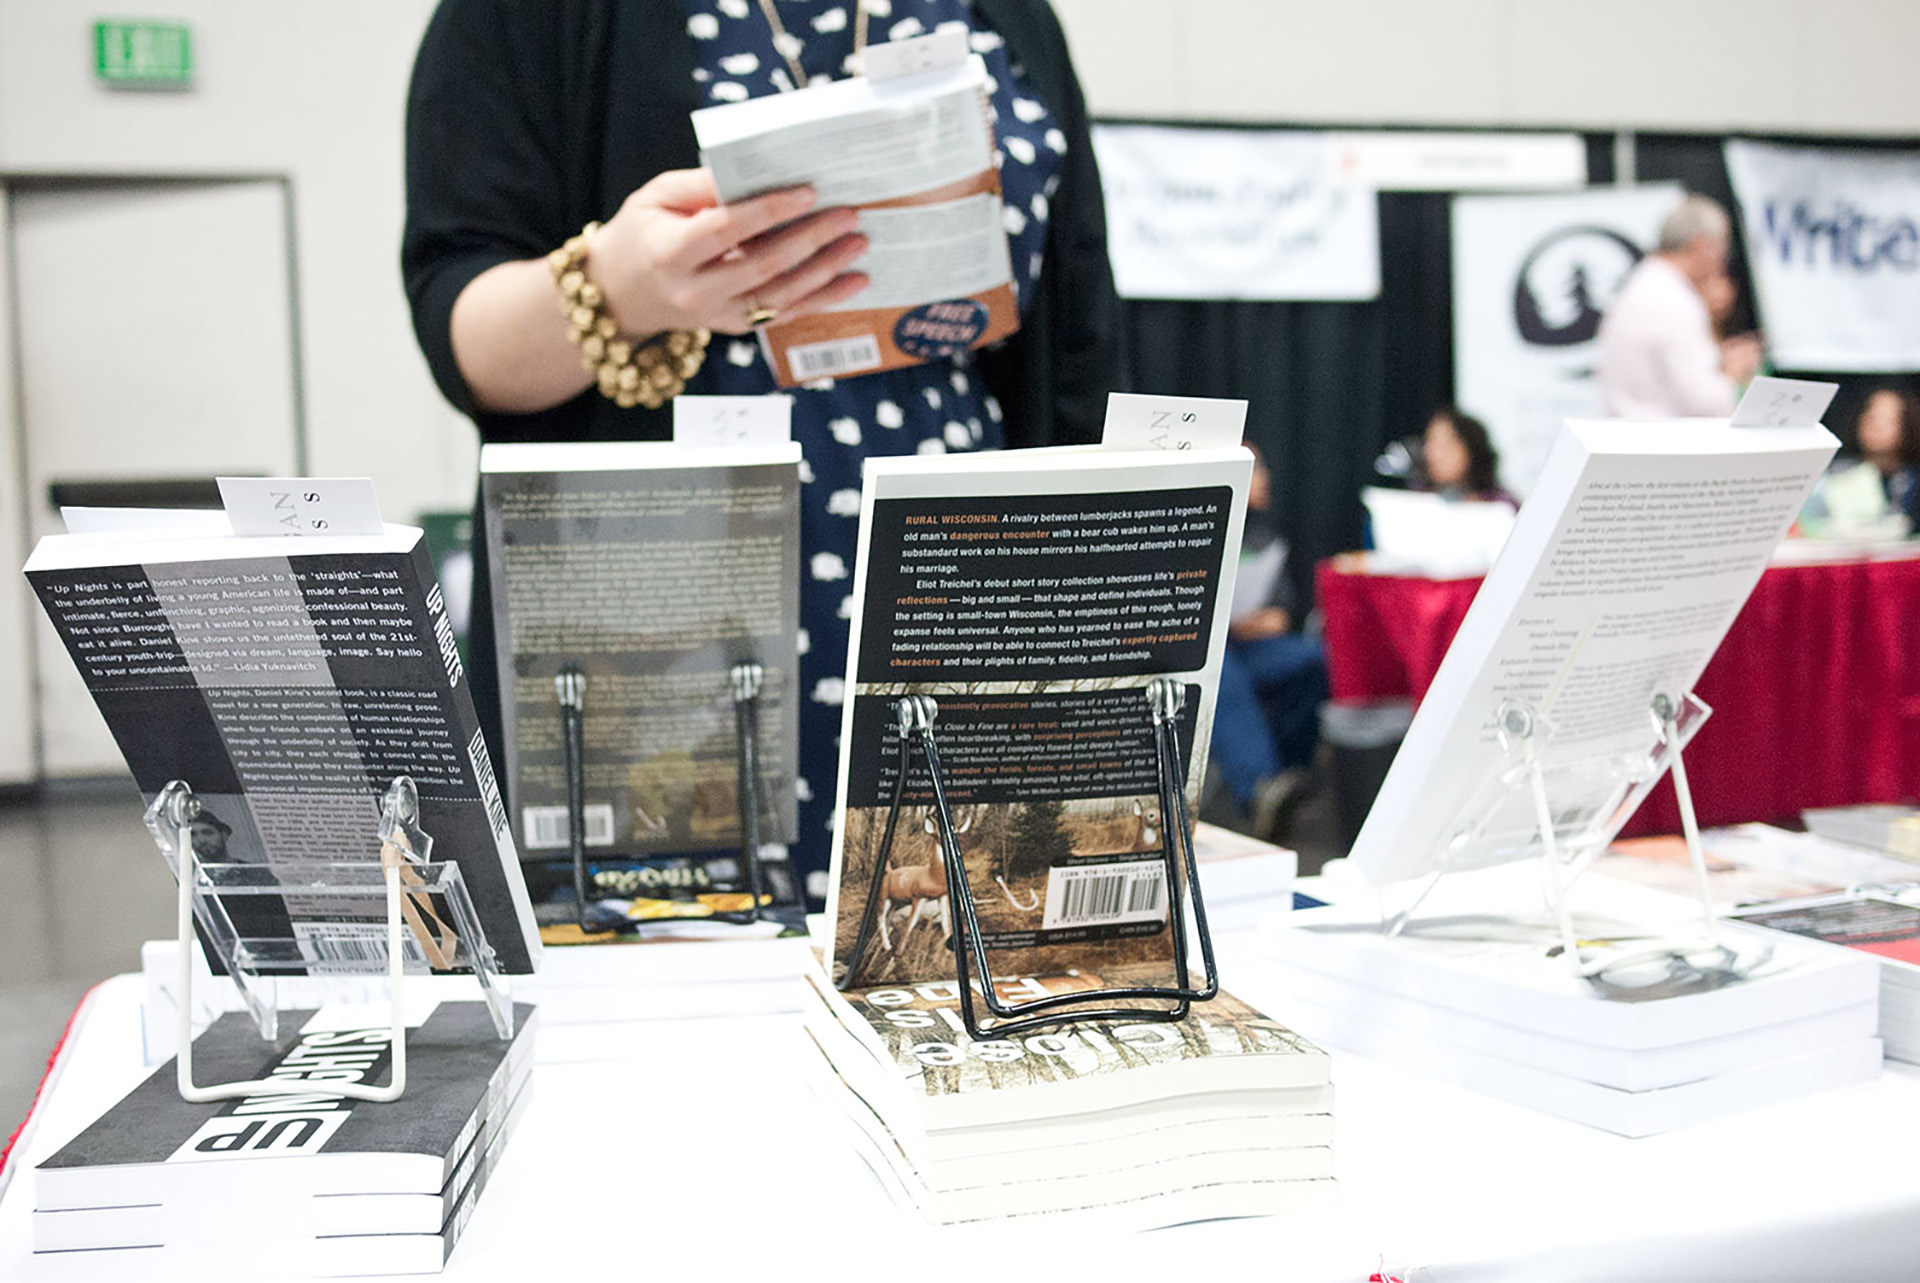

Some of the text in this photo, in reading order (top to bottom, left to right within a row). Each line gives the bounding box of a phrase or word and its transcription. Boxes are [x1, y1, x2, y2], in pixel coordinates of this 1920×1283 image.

[905, 504, 1217, 525] RURAL WISCONSIN. A rivalry between lumberjacks spawns a legend. An
[903, 532, 918, 542] old
[949, 531, 999, 542] dangerous
[1002, 529, 1050, 540] encounter
[1051, 529, 1071, 538] with
[1073, 529, 1079, 538] a
[1080, 528, 1101, 538] bear
[1102, 527, 1119, 537] cub
[1120, 525, 1147, 535] wakes
[1149, 524, 1165, 534] him
[1166, 524, 1179, 534] up.
[1181, 522, 1187, 532] A
[901, 538, 1212, 558] substandard work on his house mirrors his halfhearted attempts to repair
[899, 564, 959, 575] his marriage.
[916, 579, 936, 590] Eliot
[983, 578, 1009, 588] debut
[1011, 578, 1035, 588] short
[1037, 578, 1060, 588] story
[1061, 576, 1103, 587] collection
[1105, 573, 1152, 585] showcases
[1176, 569, 1207, 581] private
[74, 583, 108, 593] Nights
[111, 582, 122, 590] is
[126, 580, 148, 591] part
[151, 578, 188, 588] honest
[192, 575, 240, 587] reporting
[242, 573, 269, 583] back
[272, 573, 284, 582] to
[288, 573, 306, 581] the
[54, 599, 72, 608] the
[75, 596, 129, 607] underbelly
[132, 594, 143, 604] of
[145, 594, 175, 603] living
[187, 592, 219, 602] young
[221, 589, 270, 599] American
[272, 588, 290, 597] life
[294, 589, 303, 597] is
[305, 587, 334, 596] made
[381, 586, 403, 597] part
[977, 594, 994, 604] and
[1052, 593, 1079, 603] shape
[1080, 591, 1097, 602] and
[1097, 590, 1124, 601] define
[1125, 587, 1172, 599] individuals.
[1174, 584, 1204, 596] Though
[62, 601, 407, 622] intimate, fierce, unflinching, graphic, agonizing, confessional beauty.
[895, 600, 1202, 622] the setting is small-town Wisconsin, the emptiness of this rough, lonely
[426, 582, 463, 688] UP NIGHTS
[893, 616, 1199, 638] expanse feels universal. Anyone who has yearned to ease the ache of a
[891, 642, 920, 653] fading
[921, 641, 974, 652] relationship
[975, 641, 991, 651] will
[992, 641, 1003, 651] be
[1004, 641, 1024, 650] able
[1025, 640, 1034, 650] to
[1035, 639, 1070, 650] connect
[1071, 639, 1080, 649] to
[1121, 634, 1157, 646] expertly
[1158, 631, 1197, 643] captured
[890, 650, 1151, 667] characters and their plights of family, fidelity, and friendship.
[470, 732, 507, 841] DANIEL KINE
[911, 1021, 1178, 1067] Close
[195, 1117, 324, 1152] UP
